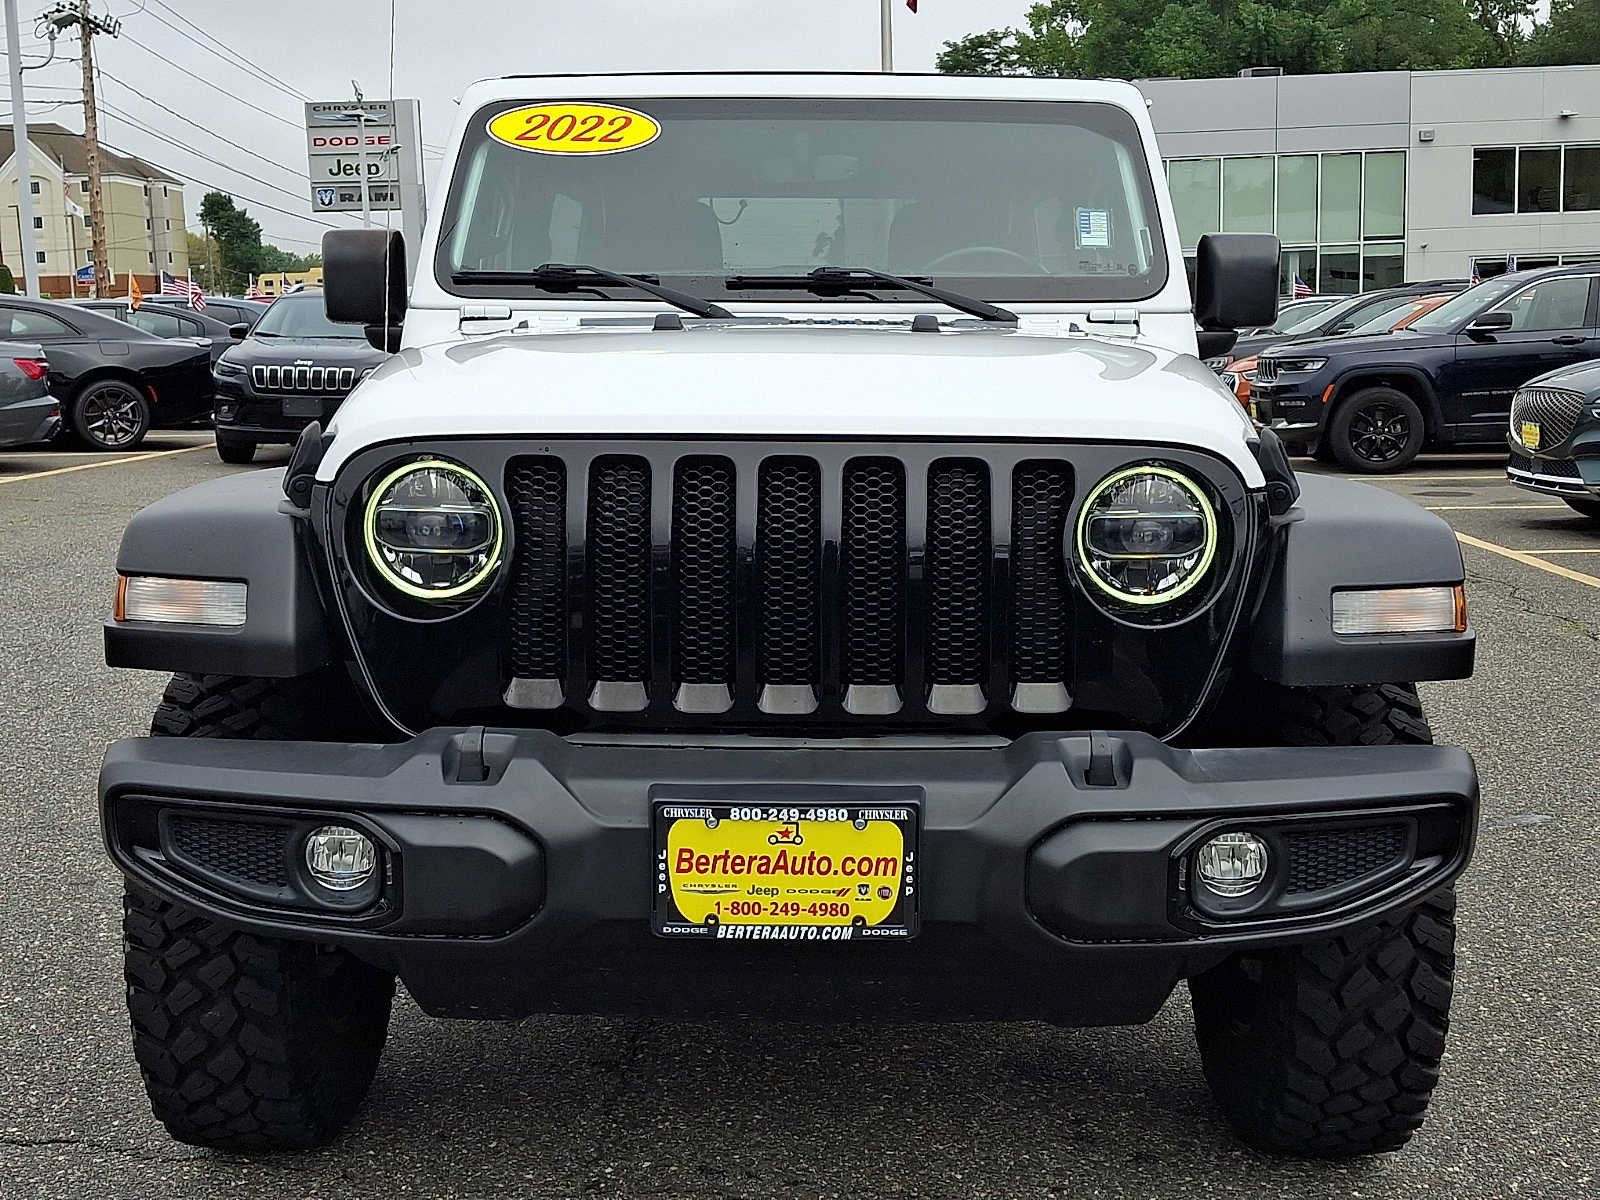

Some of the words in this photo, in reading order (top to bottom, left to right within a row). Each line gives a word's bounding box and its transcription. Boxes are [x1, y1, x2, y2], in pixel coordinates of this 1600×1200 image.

[312, 104, 387, 112] CHRYSLER
[514, 114, 633, 142] 2022
[313, 136, 391, 147] DODGE
[663, 807, 713, 819] CHRYSLER
[730, 808, 848, 821] 800-249-4980
[858, 809, 908, 820] CHRYSLER
[675, 848, 898, 876] BerteraAuto.com
[658, 849, 667, 894] Jeep
[905, 851, 914, 896] Jeep
[746, 884, 780, 897] Jeep
[714, 901, 850, 917] 1-800-249-4980
[716, 925, 853, 940] BERTERAAUTO.COM
[862, 928, 908, 936] DODGE
